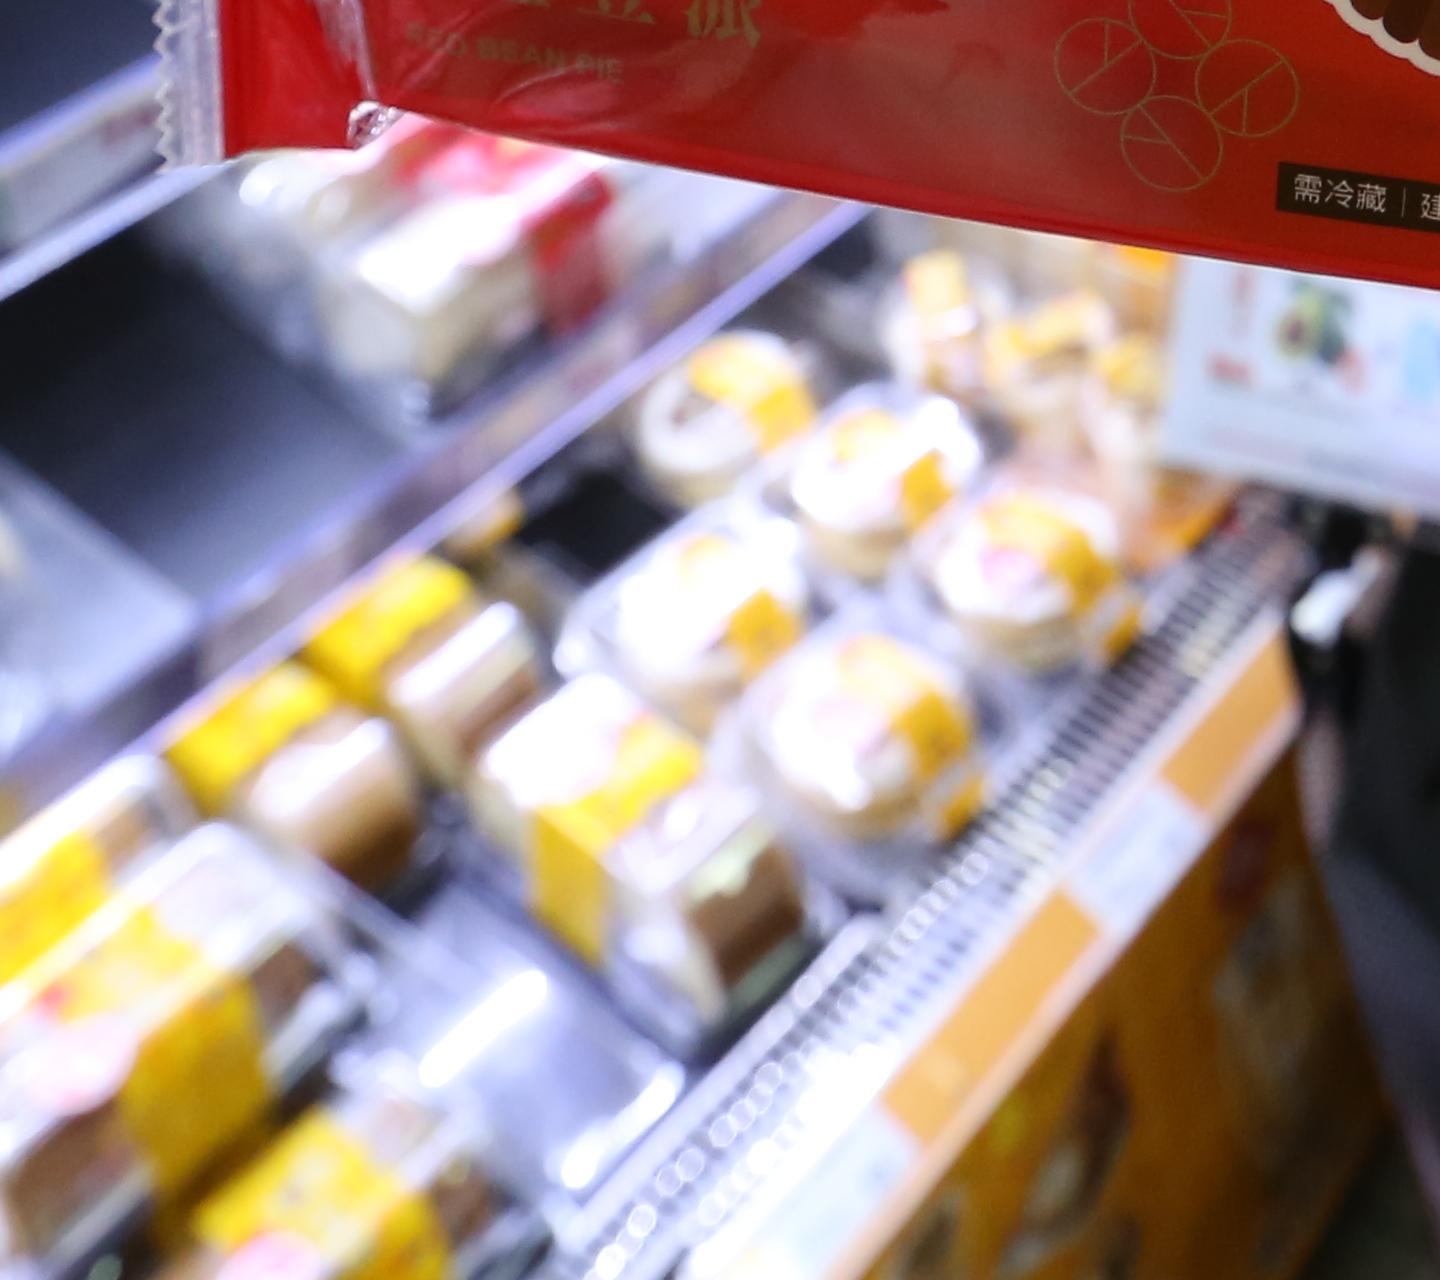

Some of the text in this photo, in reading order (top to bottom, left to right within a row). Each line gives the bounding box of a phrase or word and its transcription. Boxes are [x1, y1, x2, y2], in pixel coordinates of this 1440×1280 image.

[476, 35, 567, 71] BEAN
[573, 52, 625, 85] PIE
[1294, 173, 1388, 213] 需冷藏
